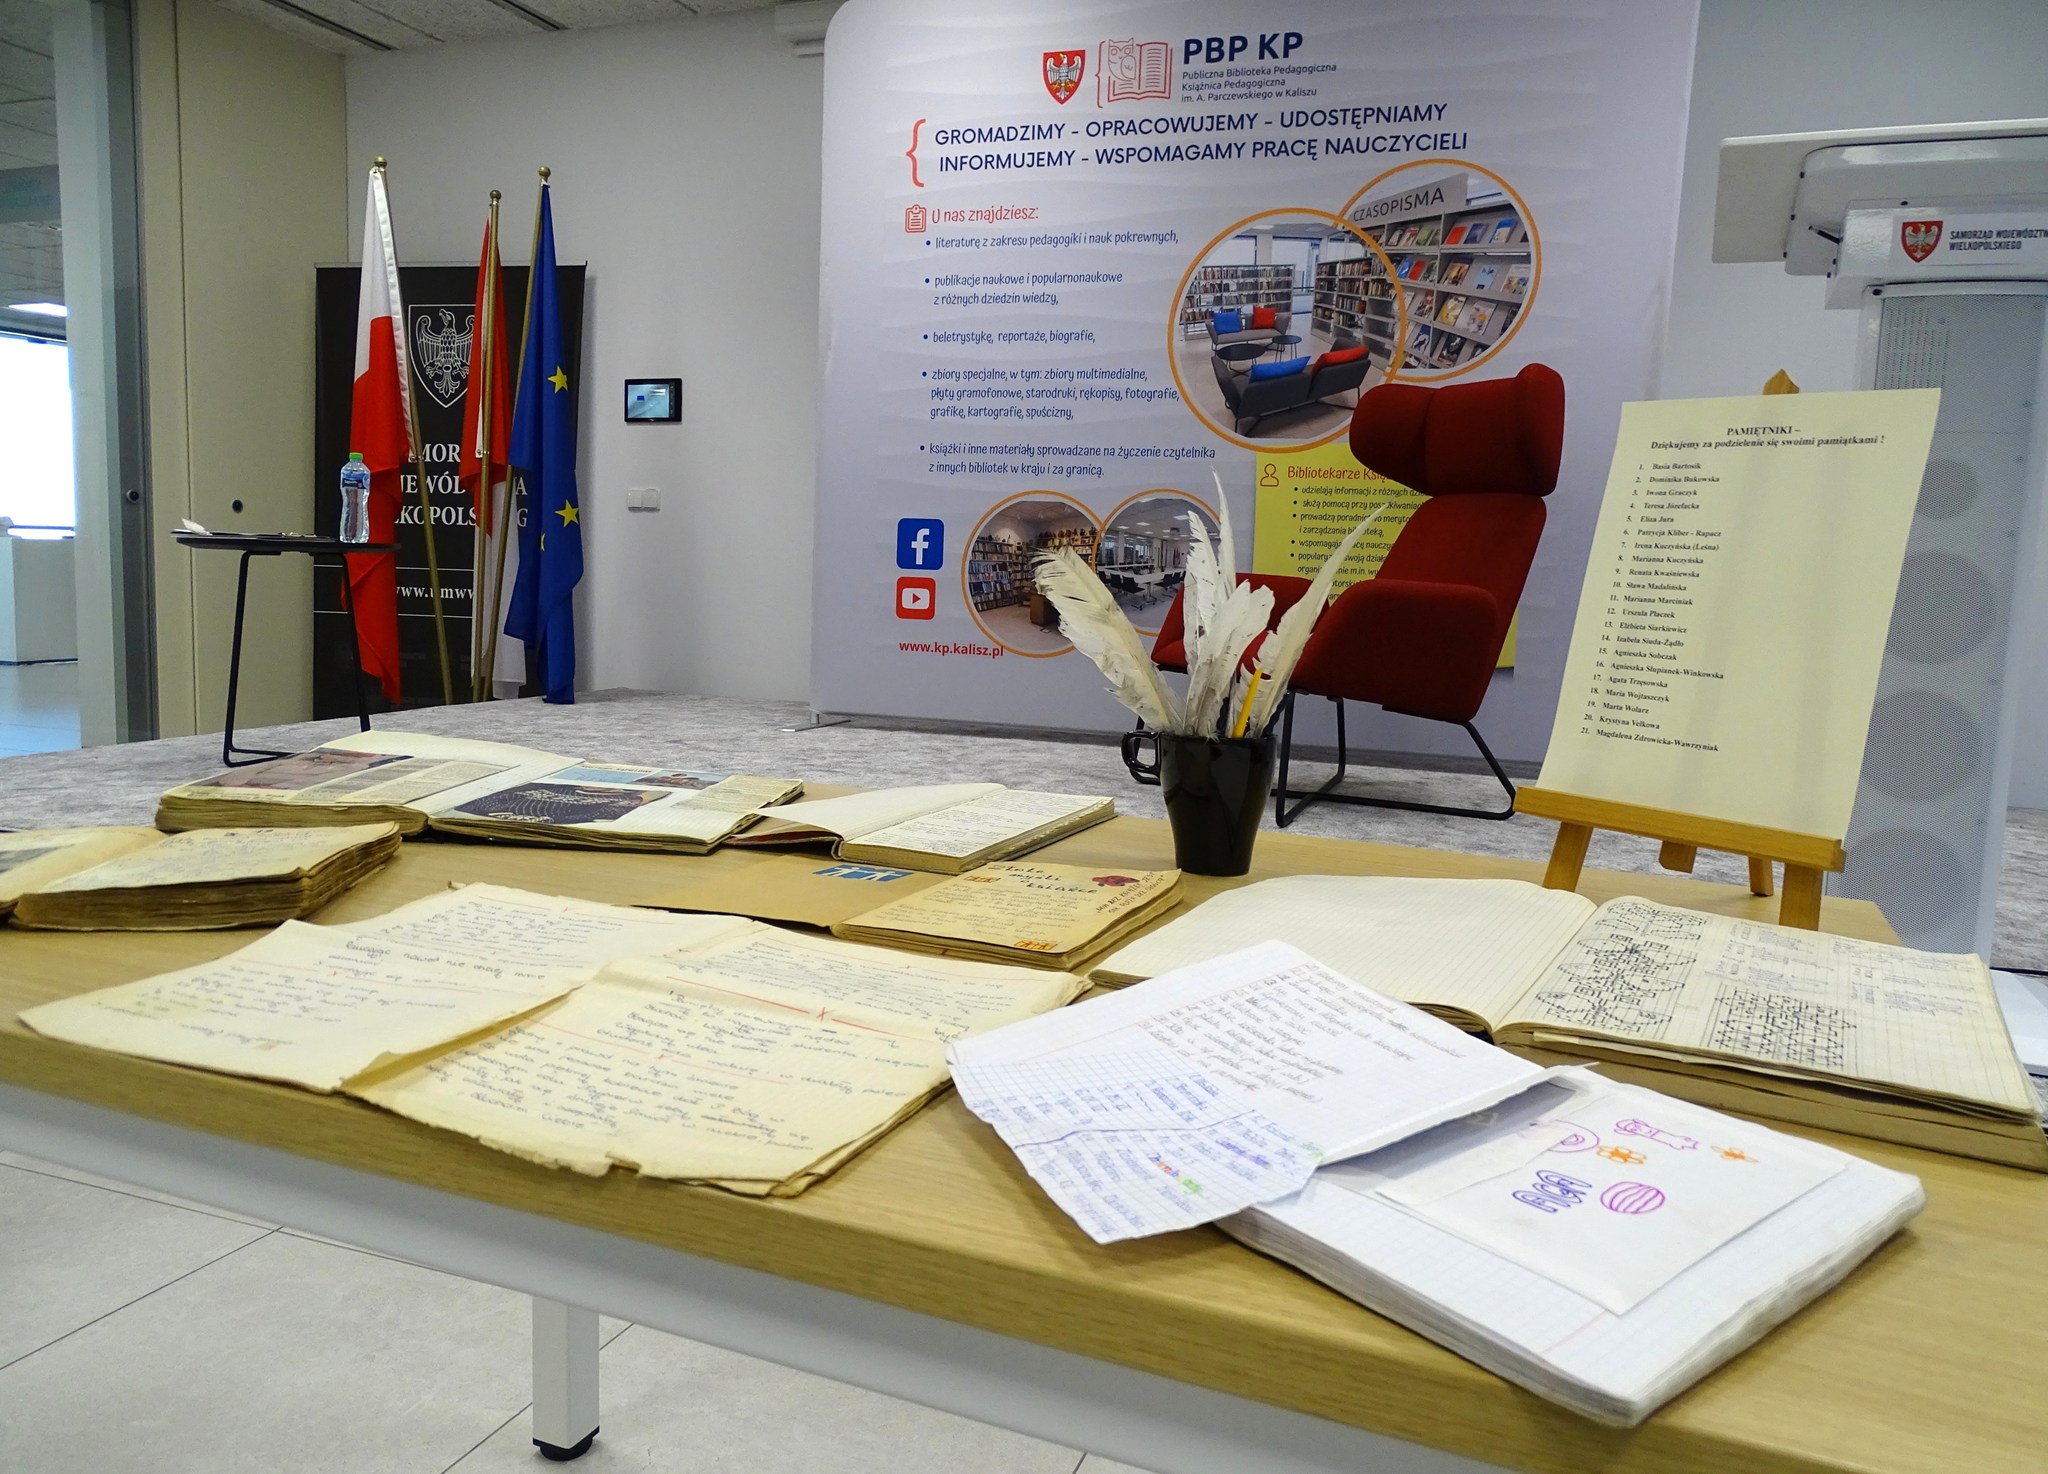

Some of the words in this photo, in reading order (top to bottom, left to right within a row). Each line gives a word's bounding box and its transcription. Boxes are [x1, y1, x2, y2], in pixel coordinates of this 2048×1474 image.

[1184, 36, 1248, 64] PBP
[1259, 32, 1303, 60] KP
[1183, 70, 1224, 80] Publiczna
[1227, 66, 1271, 77] Biblioteka
[1274, 64, 1337, 75] Pedagogiczna
[1182, 82, 1221, 92] Książnica
[1224, 78, 1285, 89] Pedagogiczna
[1182, 94, 1194, 103] im.
[1196, 94, 1205, 102] A.
[1208, 90, 1273, 101] Parczewskiego
[1286, 88, 1317, 97] Kaliszu
[935, 123, 1065, 145] GROMADZIMY
[1086, 112, 1259, 138] OPRACOWUJEMY
[1280, 104, 1447, 129] UDOSTĘPNIAMY
[939, 150, 1075, 172] INFORMUJEMY
[1095, 142, 1246, 165] WSPOMAGAMY
[1252, 139, 1318, 160] PRACĘ
[1325, 133, 1468, 154] NAUCZYCIELI
[1353, 187, 1444, 222] CZASOPISMA
[932, 209, 941, 224] U
[944, 211, 965, 223] nas
[969, 206, 1039, 227] znajdziesz:
[935, 236, 980, 249] literaturę
[982, 239, 987, 247] z
[990, 235, 1028, 247] zakresu
[1030, 232, 1082, 248] pedagogiki
[1089, 233, 1112, 244] nauk
[1115, 230, 1178, 245] pokrewnych,
[1950, 230, 1993, 240] SAMORZĄD
[1996, 228, 2048, 239] WOJEWÓDZTW
[1949, 241, 2022, 251] WIELKOPOLSKIEGO
[935, 274, 980, 288] publikacje
[983, 273, 1024, 284] naukowe
[1032, 271, 1122, 286] popularnonaukowe
[934, 296, 939, 304] z
[941, 293, 979, 307] różnych
[981, 293, 1020, 304] dziedzin
[1022, 292, 1058, 306] wiedzy,
[933, 331, 994, 344] beletrystykę,
[998, 330, 1048, 344] reportaże,
[1050, 330, 1095, 343] biografie,
[932, 369, 961, 382] zbiory
[962, 369, 1008, 382] specjalne,
[1010, 370, 1018, 379] w
[1021, 369, 1042, 382] tym:
[1044, 369, 1074, 382] zbiory
[1077, 368, 1147, 381] multimedialne,
[931, 388, 954, 401] płyty
[956, 388, 1023, 401] gramofonowe,
[1026, 388, 1078, 400] starodruki,
[1080, 387, 1122, 402] rękopisy,
[1125, 387, 1179, 402] fotografie,
[930, 407, 965, 419] grafikę,
[967, 406, 1024, 420] kartografię,
[1026, 406, 1073, 420] spuścizny,
[1727, 426, 1792, 437] PAMIĘTNIKI
[1651, 441, 1699, 450] Dziękujemy
[1714, 438, 1765, 450] podzielenie
[1767, 439, 1778, 448] się
[1782, 437, 1815, 446] swoimi
[1817, 436, 1877, 447] pamiątkami
[930, 443, 961, 455] książki
[968, 444, 987, 454] inne
[989, 443, 1034, 457] materiały
[1037, 444, 1101, 459] sprowadzane
[1103, 448, 1115, 457] na
[1118, 446, 1161, 459] życzenie
[1163, 446, 1215, 460] czytelnika
[929, 465, 934, 473] z
[936, 462, 967, 475] innych
[969, 462, 1008, 474] bibliotek
[1011, 465, 1019, 473] w
[1021, 463, 1045, 476] kraju
[1052, 466, 1064, 474] za
[1066, 464, 1104, 478] granicą.
[1288, 466, 1360, 479] Bibliotekarze
[1302, 487, 1332, 495] udzielają
[1334, 486, 1371, 496] informacji
[1378, 487, 1408, 497] różnych
[1303, 500, 1320, 508] służą
[1322, 501, 1349, 510] pomocą
[1351, 502, 1367, 510] przy
[1301, 514, 1335, 523] prowadzą
[1303, 527, 1346, 536] zarządzania
[1637, 529, 1665, 537] Patrycja
[1666, 556, 1704, 564] Kuczyńska
[1654, 570, 1700, 578] Kwaśniewska
[1648, 583, 1686, 591] Madalińska
[1624, 595, 1656, 603] Marianna
[1658, 597, 1693, 605] Marciniak
[1620, 622, 1646, 631] Elżbieta
[1648, 624, 1687, 633] Siarkiewicz
[1617, 635, 1641, 643] Izabela
[1642, 637, 1684, 648] Siuda-Żądło
[899, 641, 1004, 659] www.kp.kalisz.pl
[1615, 649, 1647, 659] Agnieszka
[1649, 652, 1677, 660] Sobczak
[1611, 663, 1645, 673] Agnieszka
[1608, 675, 1627, 684] Agata
[1629, 678, 1668, 688] Trzęsowska
[1606, 689, 1625, 697] Maria
[1627, 691, 1669, 702] Wojtaszczyk
[1603, 702, 1623, 711] Marta
[1625, 705, 1649, 714] Wolarz
[1600, 716, 1629, 726] Krystyna
[1632, 719, 1660, 730] Velkowa
[1596, 729, 1632, 740] Magdalena
[1634, 734, 1718, 752] Zdrowicka-Wawrzyniak
